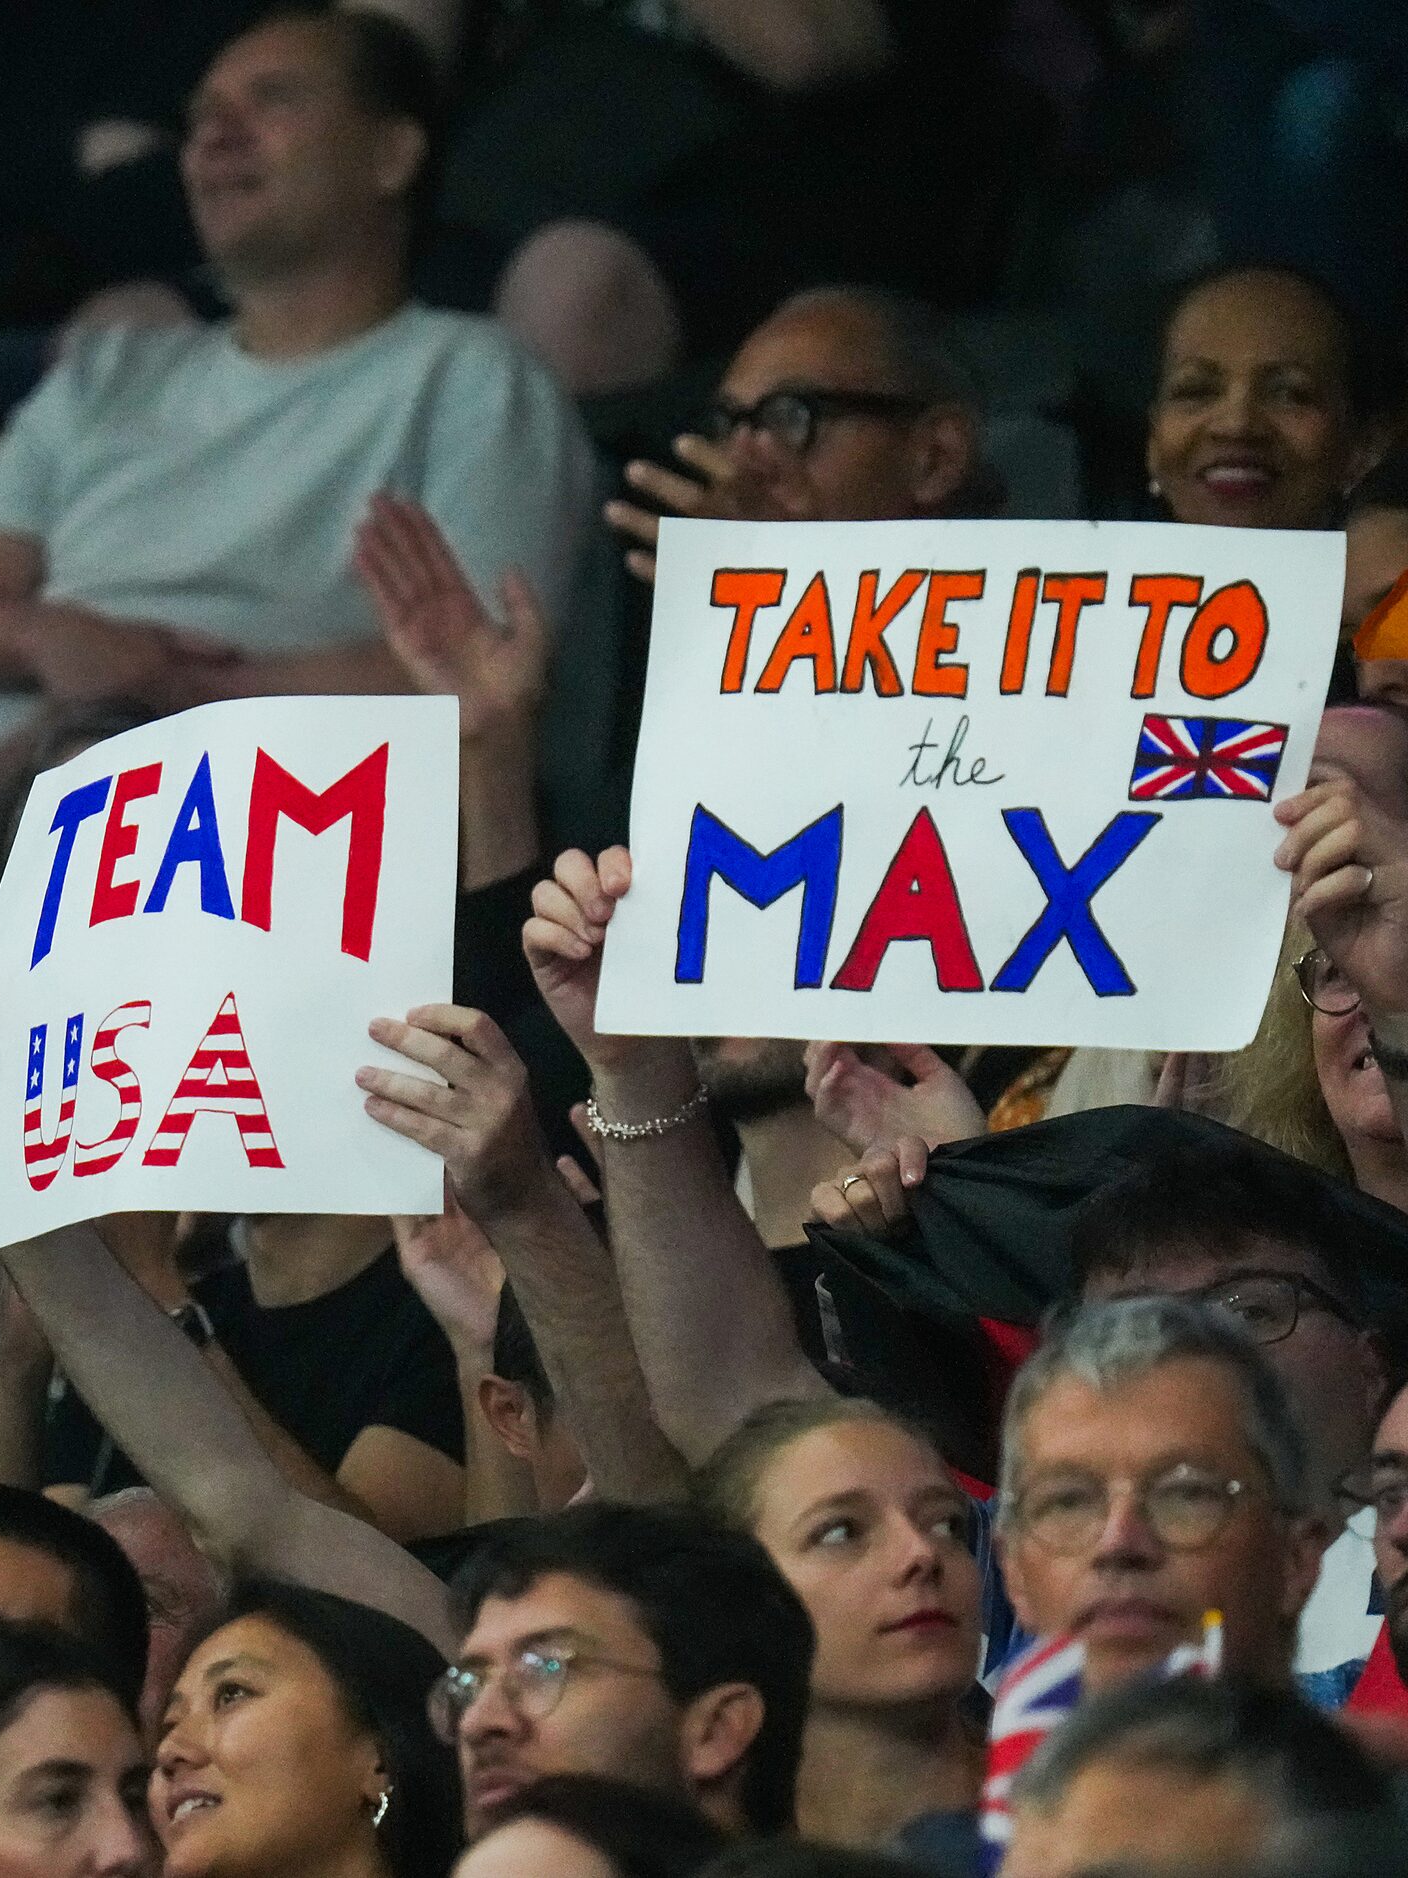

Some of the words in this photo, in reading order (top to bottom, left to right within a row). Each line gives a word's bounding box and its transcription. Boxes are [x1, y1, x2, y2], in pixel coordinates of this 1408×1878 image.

[710, 567, 986, 699] TAKE
[999, 568, 1108, 697] IT
[1128, 573, 1269, 700] TO
[900, 714, 1005, 789] the
[29, 741, 389, 971] TEAM
[674, 803, 1163, 997] MAX
[23, 991, 286, 1191] USA
